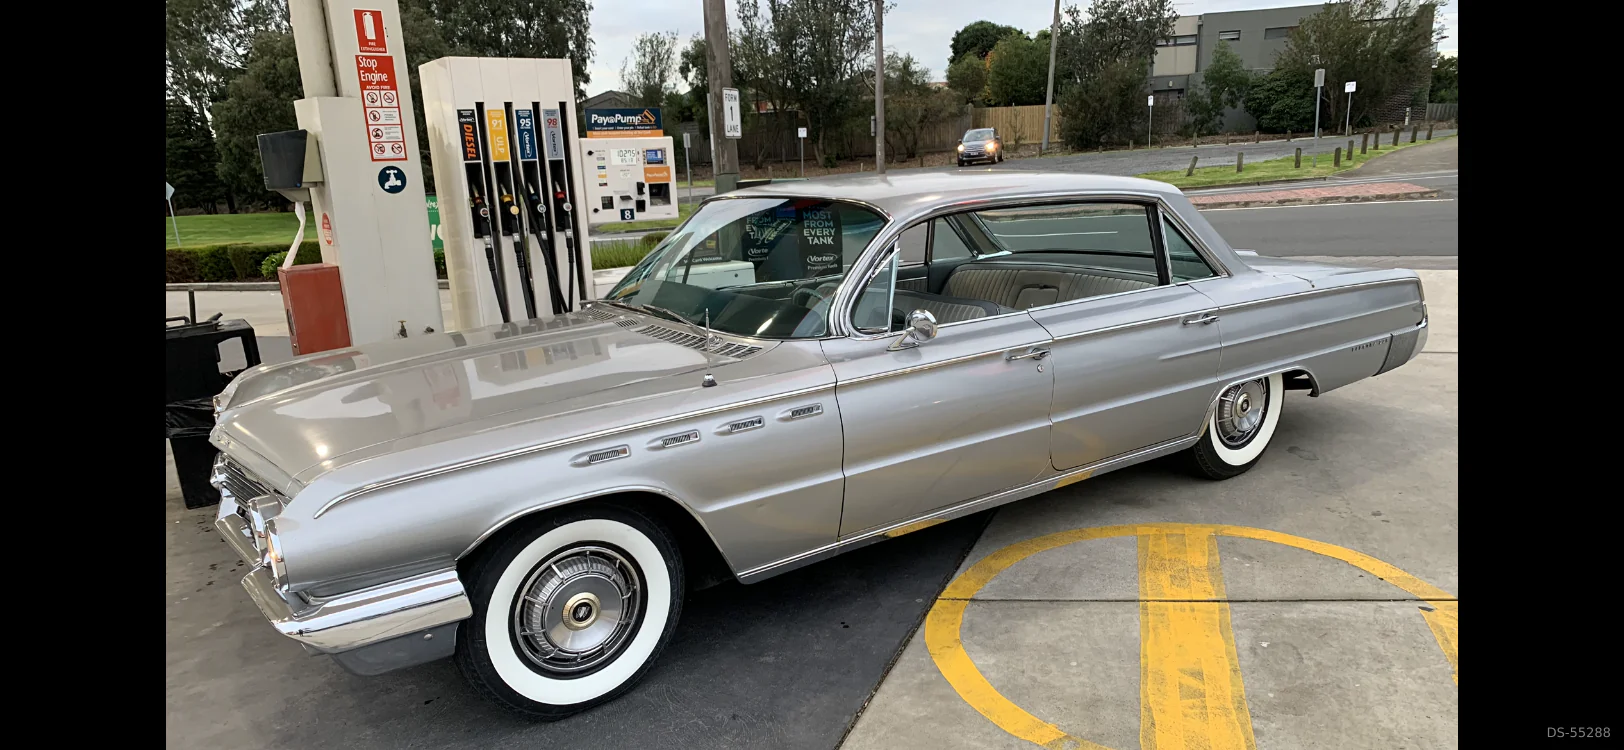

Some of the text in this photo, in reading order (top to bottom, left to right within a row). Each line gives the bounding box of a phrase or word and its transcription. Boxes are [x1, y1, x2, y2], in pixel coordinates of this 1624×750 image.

[358, 56, 378, 70] Stop
[359, 70, 388, 84] Engine
[724, 93, 738, 102] FORM
[491, 119, 503, 128] 91
[519, 118, 531, 127] 95
[547, 118, 558, 126] 98
[726, 124, 739, 133] LANE
[463, 123, 477, 159] DIESEL
[496, 136, 505, 154] ULP
[624, 209, 632, 220] 8
[802, 210, 832, 220] MOST
[804, 220, 834, 228] FROM
[803, 227, 836, 236] EVERY
[807, 236, 834, 245] TANK
[809, 254, 835, 262] Vortex
